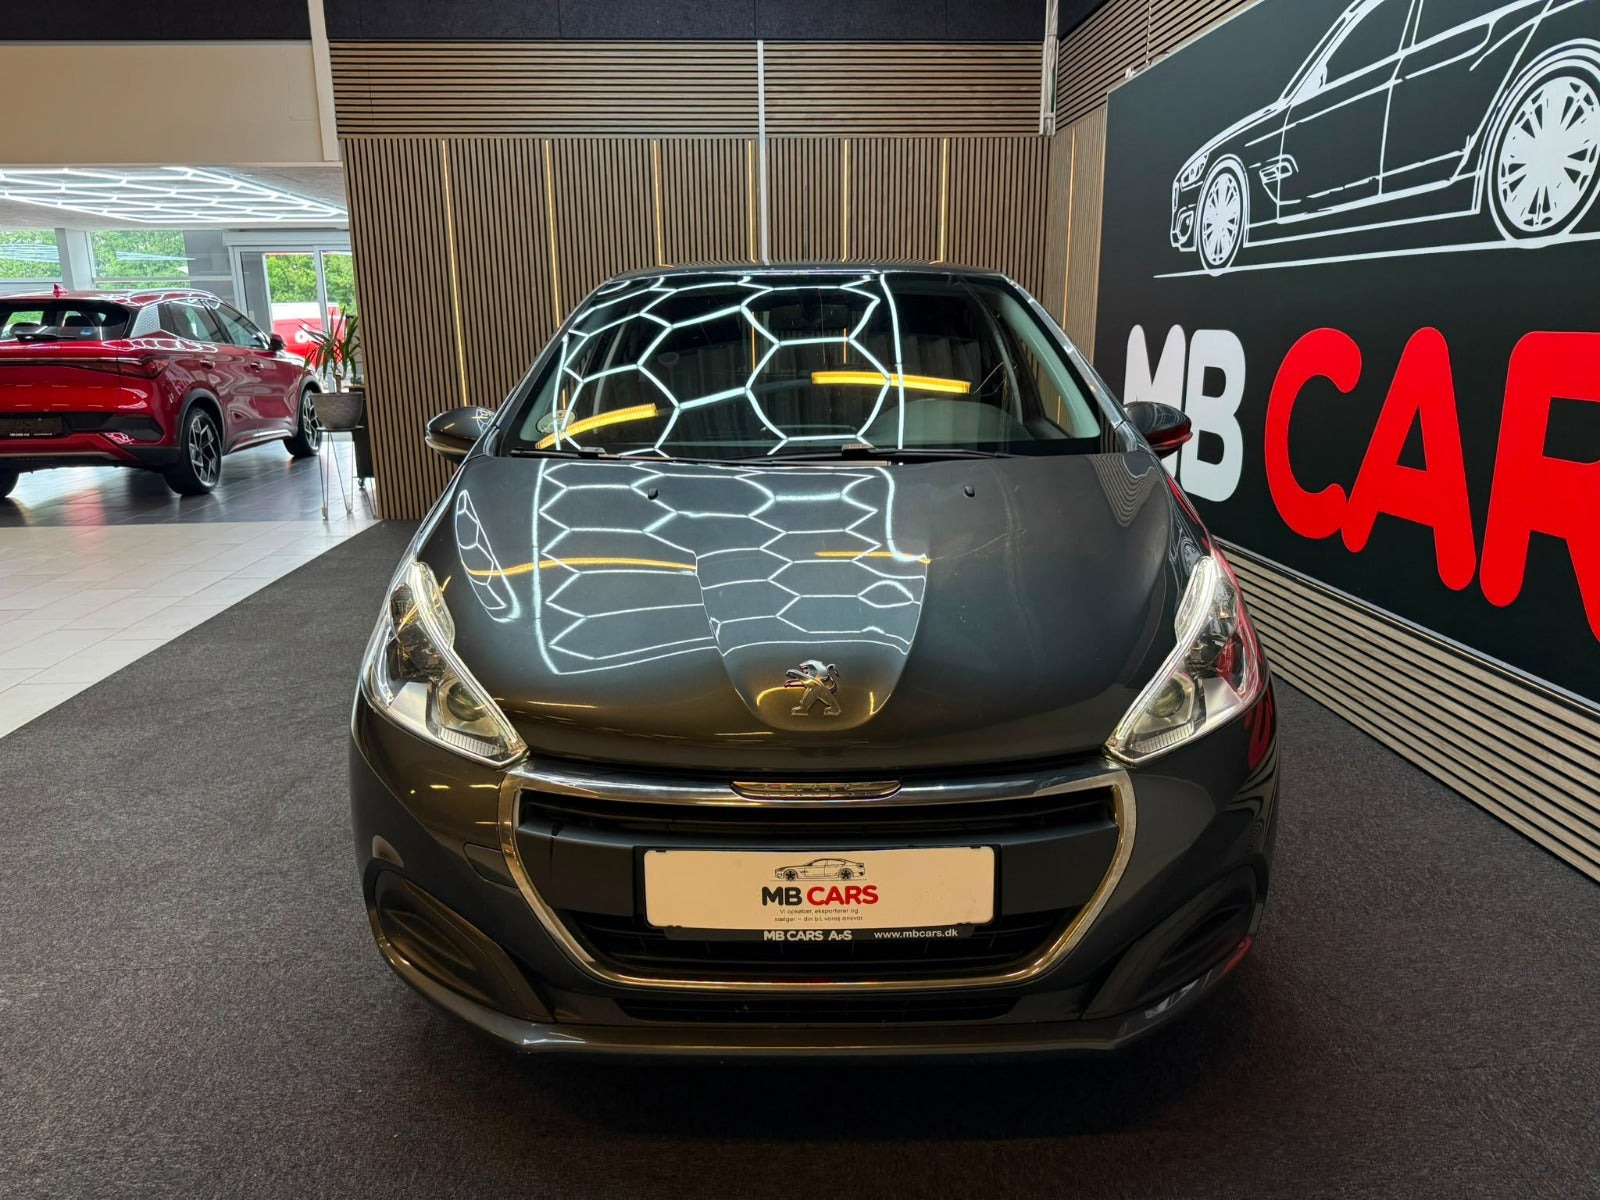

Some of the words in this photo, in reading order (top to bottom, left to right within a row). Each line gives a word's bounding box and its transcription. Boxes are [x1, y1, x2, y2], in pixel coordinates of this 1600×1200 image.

[1122, 324, 1247, 502] MB
[761, 886, 803, 906] MB
[806, 885, 879, 906] CARS
[763, 931, 785, 941] MB
[786, 930, 823, 941] CARS
[873, 928, 958, 939] www.mbcars.dk
